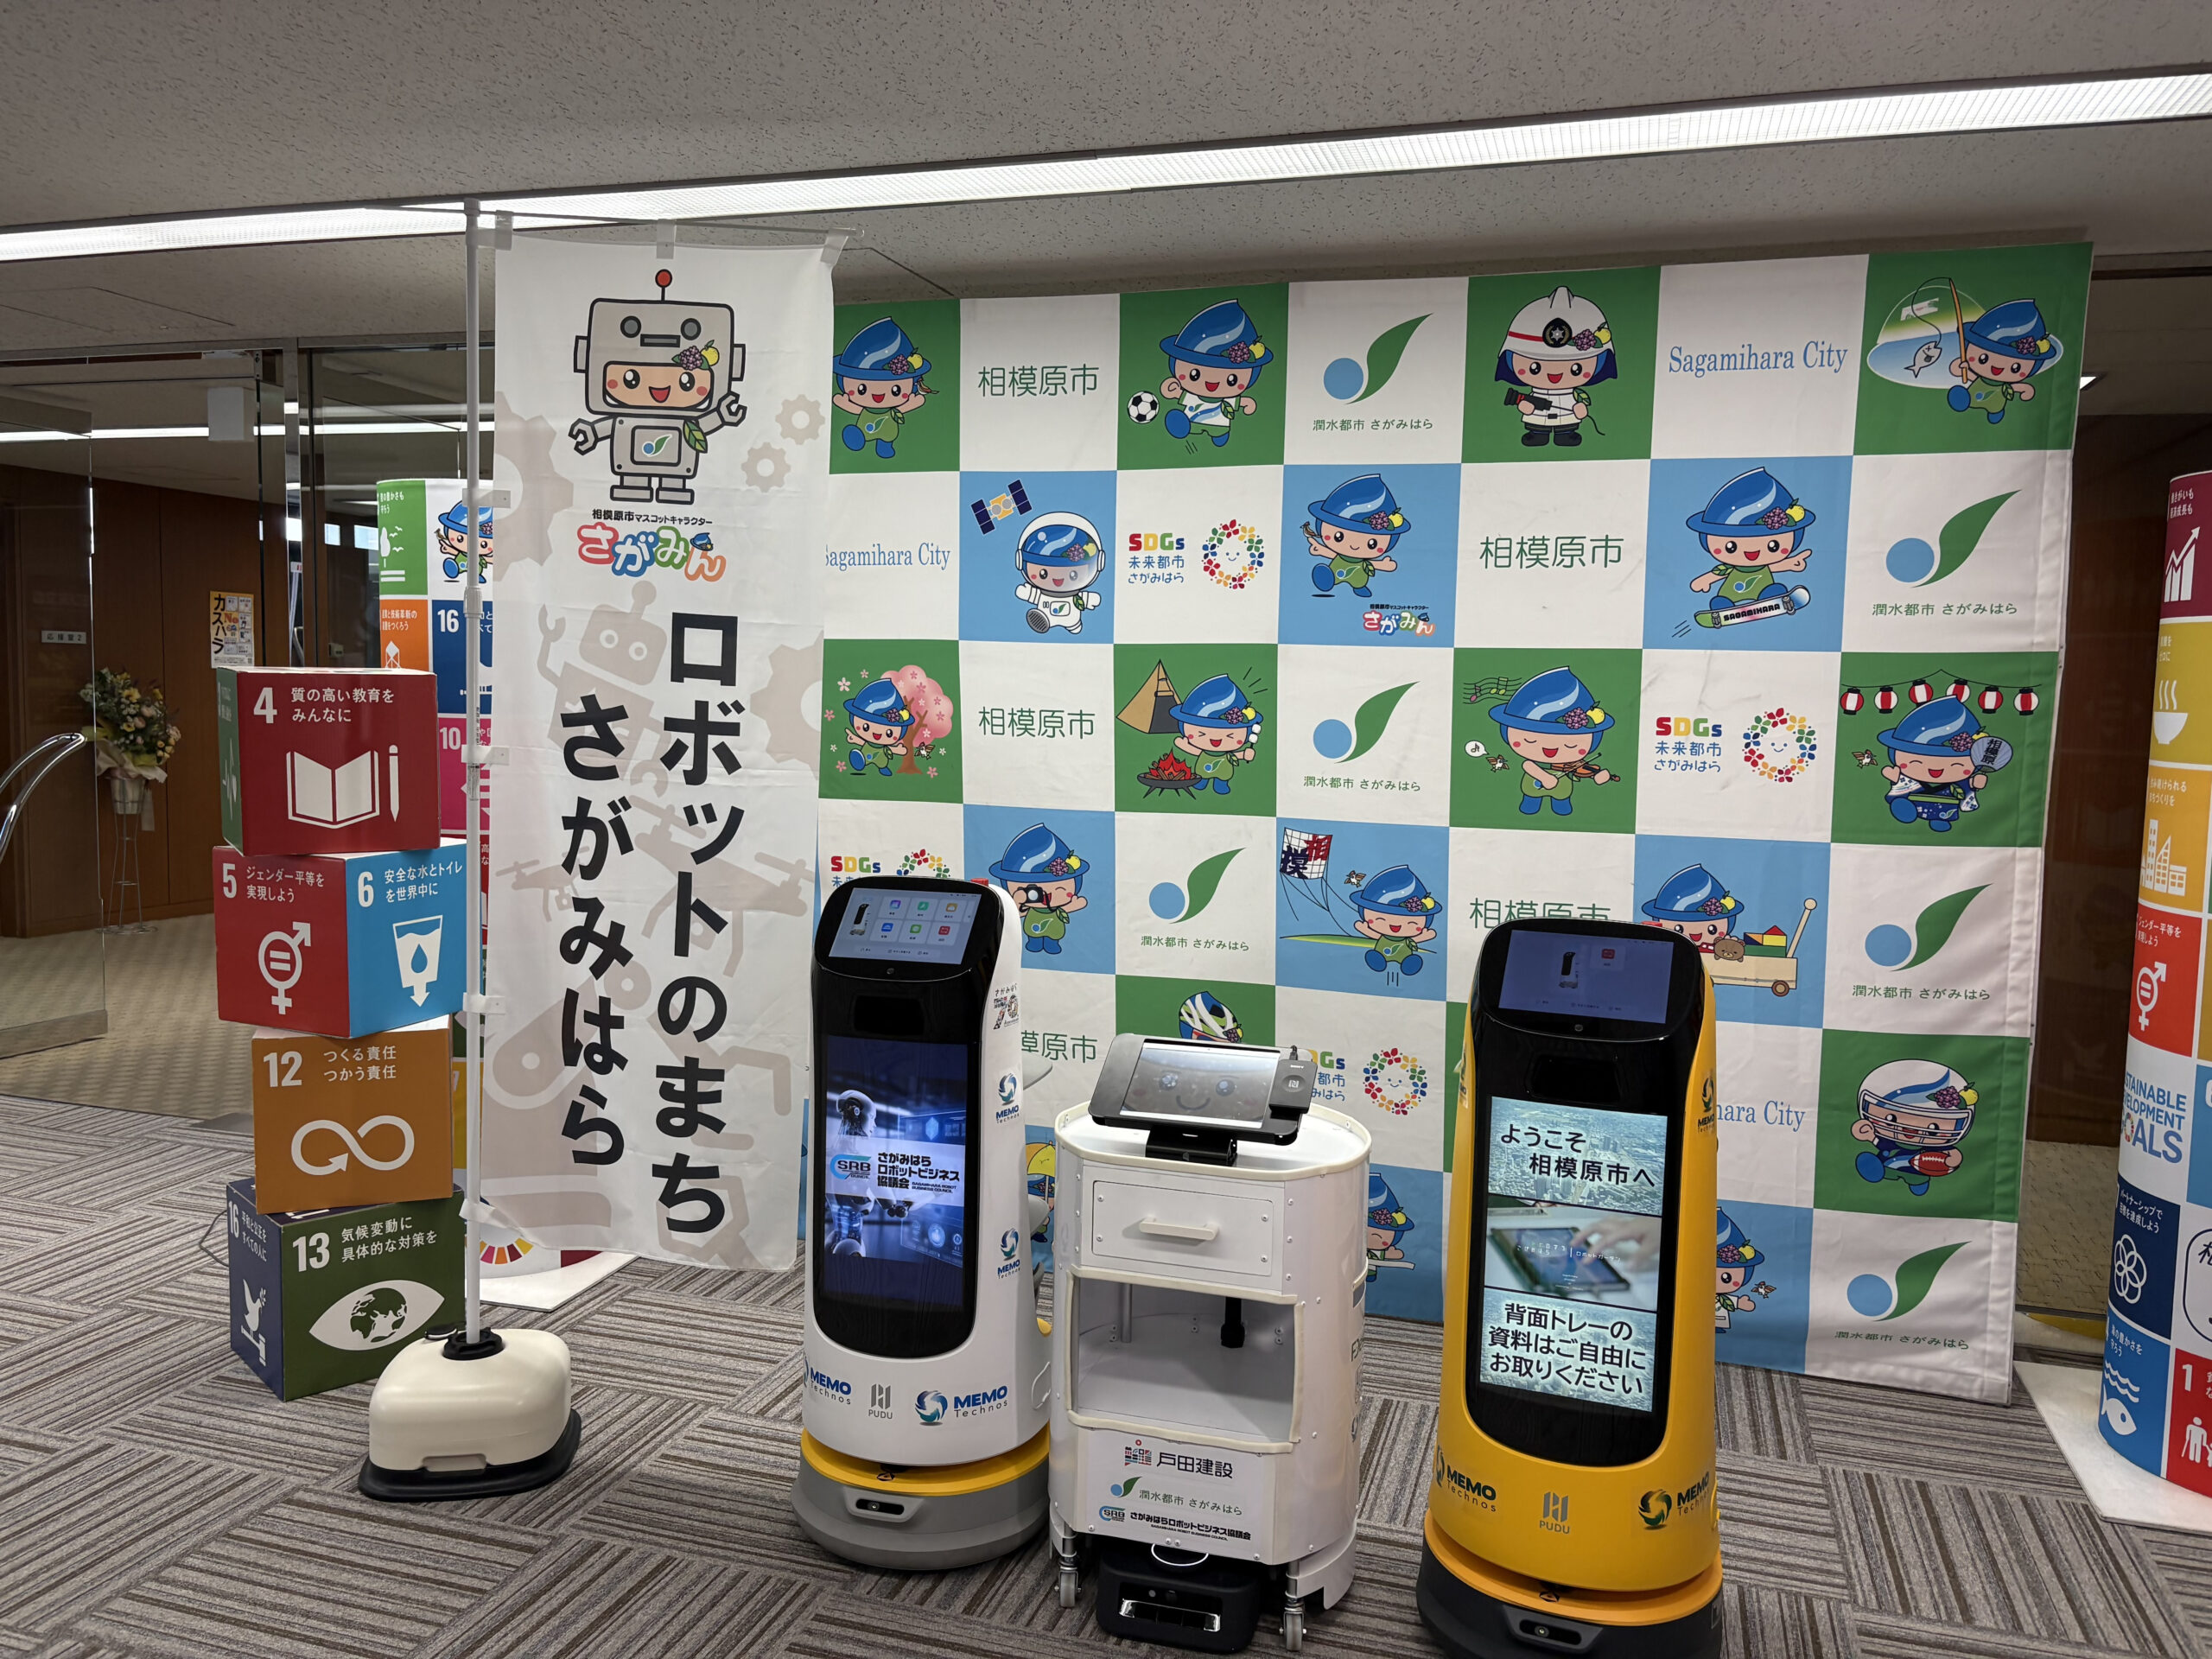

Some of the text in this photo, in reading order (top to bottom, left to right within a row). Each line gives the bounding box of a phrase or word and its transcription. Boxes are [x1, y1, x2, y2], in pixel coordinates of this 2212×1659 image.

[1669, 340, 1848, 378] Sagamihara City
[977, 363, 1099, 398] 相模原市
[1313, 417, 1433, 431] 潤水都市 さがみはら
[592, 508, 713, 526] 相模原市マスコットキャラクター
[577, 522, 727, 582] さがみん
[1128, 532, 1185, 551] SDGs
[1479, 534, 1624, 569] 相模原市
[918, 542, 950, 570] City
[1128, 555, 1185, 569] 未来都市
[1128, 571, 1185, 584] さがみはら
[437, 610, 460, 632] 16
[1724, 602, 1781, 622] SAGAMIHARA
[1872, 602, 2018, 617] 潤水都市 さがみはら
[1363, 610, 1436, 637] さがみん
[253, 687, 277, 724] 4
[291, 687, 395, 704] 質の高い教育を
[292, 708, 353, 723] みんなに
[978, 707, 1096, 740] 相模原市
[1656, 716, 1722, 737] SDGs
[439, 727, 461, 751] 10
[1655, 741, 1722, 757] 未来都市
[1654, 759, 1721, 772] さがみはら
[1303, 776, 1421, 792] 潤水都市 さがみはら
[385, 861, 463, 884] 安全な水とトイレ
[831, 855, 880, 874] SDGs
[222, 863, 237, 899] 5
[246, 866, 325, 888] ジェンダー平等を
[246, 885, 296, 903] 実現しよう
[358, 871, 374, 907] 6
[386, 881, 439, 903] を世界中に
[559, 694, 634, 1166] さがみはら
[652, 612, 745, 1234] ロボットのまち
[1141, 935, 1249, 950] 潤水都市 さがみはら
[1853, 985, 1991, 1001] 潤水都市 さがみはら
[323, 1046, 397, 1063] つくる責任
[264, 1051, 303, 1087] 12
[323, 1065, 397, 1082] つかう責任
[996, 1105, 1019, 1120] MEMO
[1764, 1100, 1806, 1132] City
[1501, 1124, 1586, 1154] ようこそ
[837, 1160, 871, 1171] SRB
[878, 1152, 931, 1166] さがみはら
[1529, 1153, 1656, 1187] 相模原市へ
[878, 1164, 960, 1182] ロボットビジネス
[878, 1175, 910, 1190] 協議会
[228, 1200, 239, 1238] 16
[341, 1215, 414, 1243] 気候変動に
[292, 1232, 331, 1272] 13
[341, 1230, 437, 1262] 具体的な対策を
[997, 1259, 1020, 1274] MEMO
[1505, 1303, 1633, 1340] 背面トレーの
[1489, 1326, 1646, 1370] 資料はご自由に
[1834, 1331, 1970, 1351] 潤水都市 さがみはら
[810, 1367, 851, 1395] MEMO
[1490, 1352, 1643, 1395] お取りください
[2182, 1363, 2193, 1392] 1
[811, 1380, 851, 1405] Technos
[954, 1385, 1008, 1408] MEMO
[868, 1408, 893, 1420] PUDU
[954, 1400, 1008, 1418] Technos
[1156, 1452, 1233, 1478] 戸田建設
[1446, 1465, 1497, 1501] MEMO
[1677, 1471, 1709, 1507] MEMO
[1140, 1490, 1243, 1516] 潤水都市 さがみはら
[1447, 1480, 1497, 1512] Technos
[1103, 1509, 1125, 1518] SRB
[1130, 1511, 1251, 1541] さがみはらロボットビジネス協議会
[1539, 1520, 1570, 1535] PUDU
